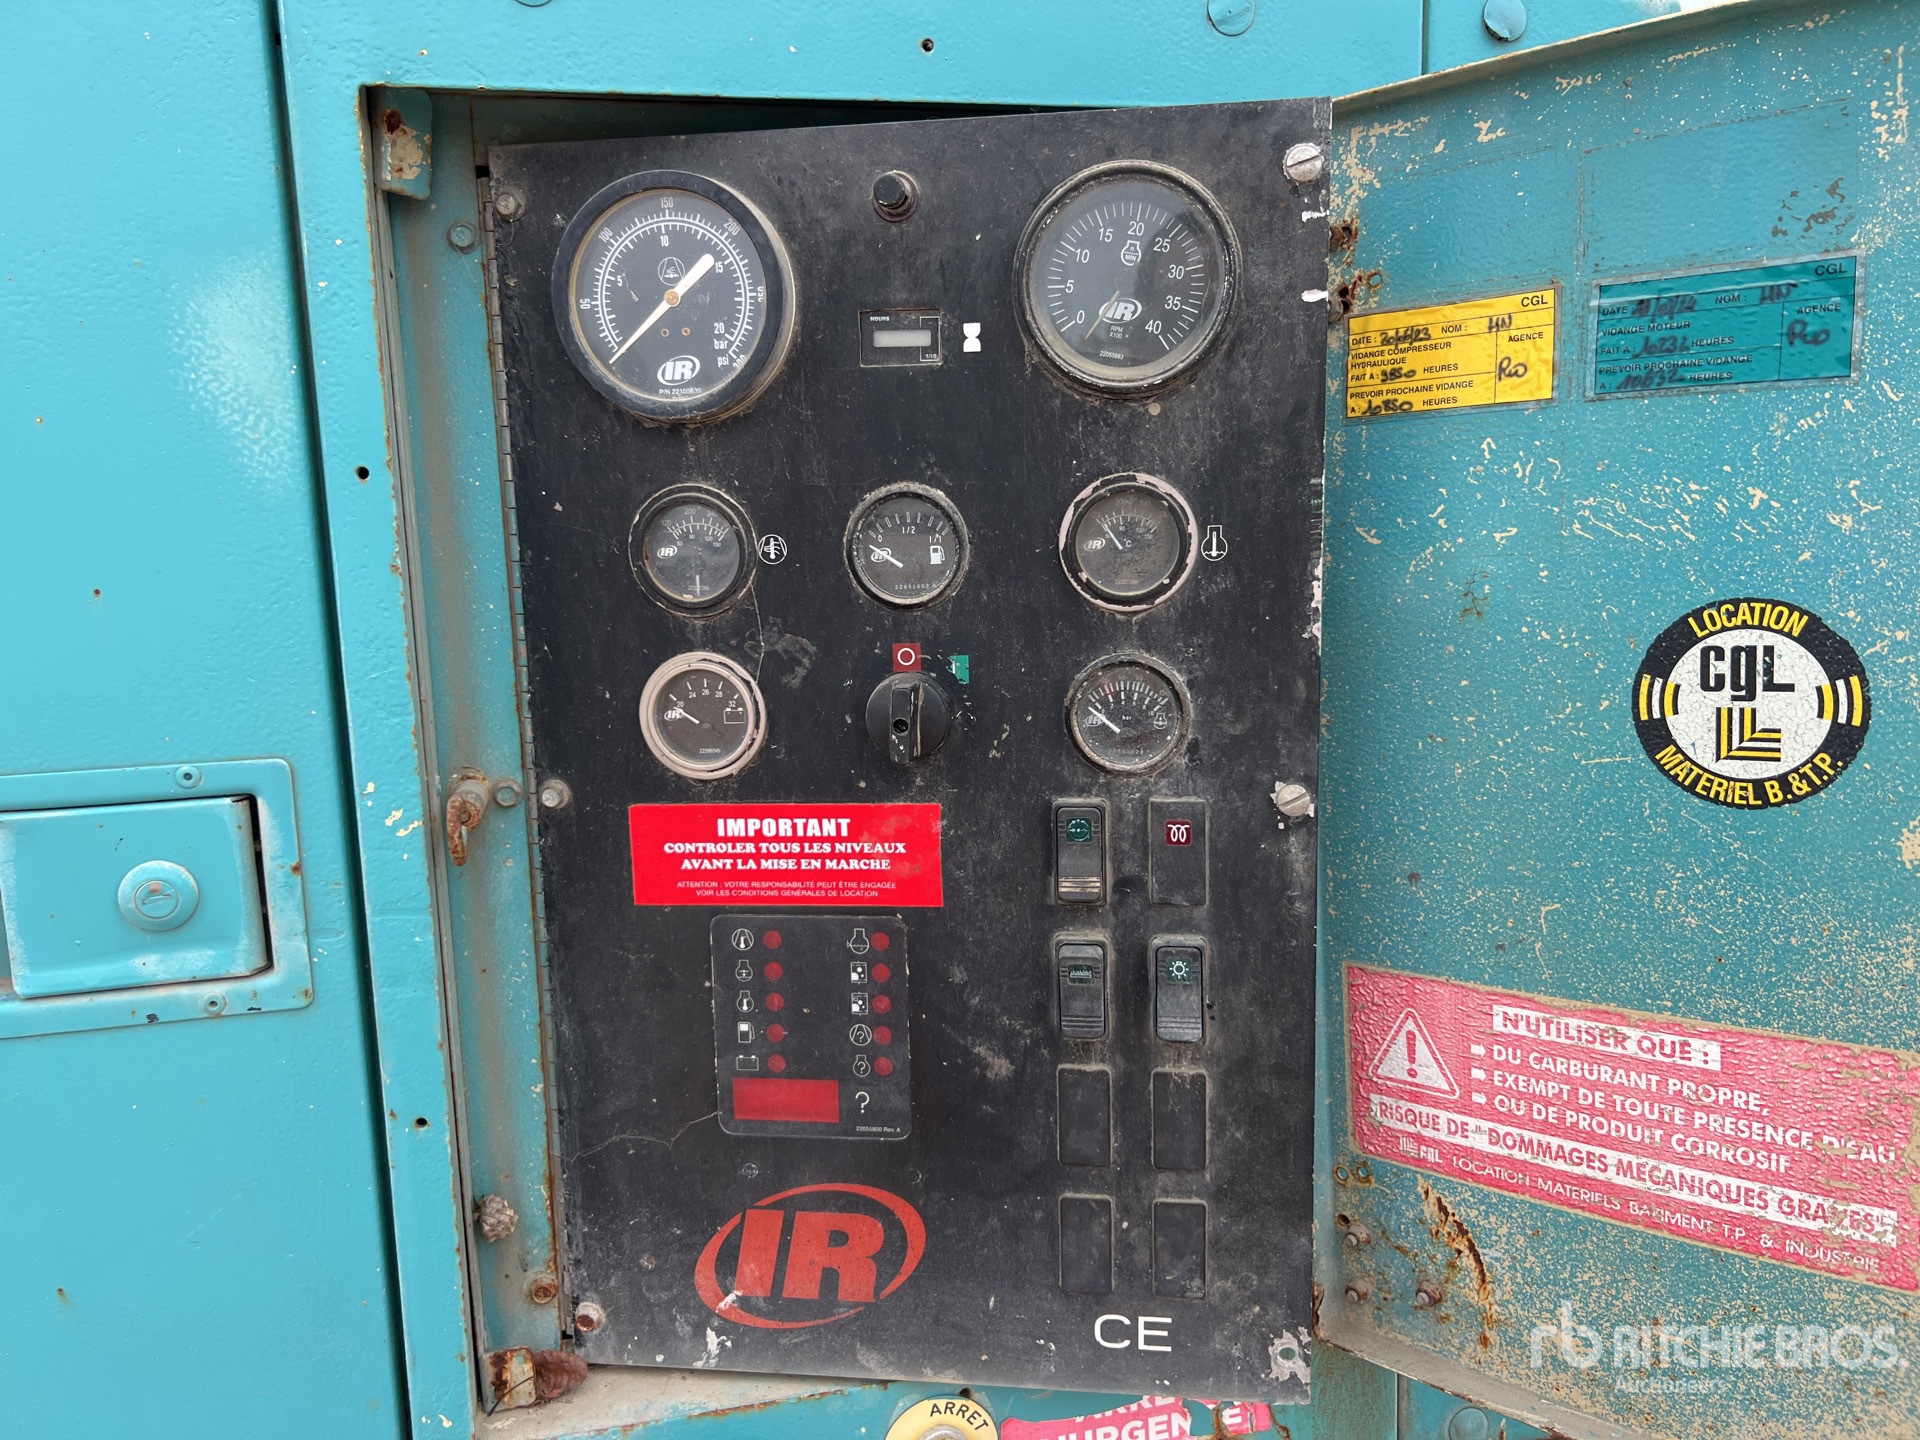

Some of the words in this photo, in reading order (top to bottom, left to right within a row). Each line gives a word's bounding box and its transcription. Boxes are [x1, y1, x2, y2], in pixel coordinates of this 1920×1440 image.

[660, 197, 674, 208] 150
[724, 218, 741, 236] 200
[1128, 221, 1144, 236] 20
[598, 226, 614, 243] 100
[660, 236, 670, 247] 10
[1098, 228, 1113, 242] 15
[1154, 238, 1170, 252] 25
[1075, 250, 1090, 264] 10
[715, 262, 724, 274] 15
[1168, 265, 1184, 280] 30
[1814, 264, 1847, 277] CGL
[617, 276, 623, 287] 5
[1066, 280, 1074, 293] 5
[580, 298, 590, 310] 50
[1164, 296, 1181, 310] 35
[1521, 295, 1548, 307] CGL
[1603, 306, 1628, 316] DATE
[1715, 294, 1740, 304] NOM
[1797, 303, 1841, 314] AGENCE
[1076, 310, 1084, 324] 0
[714, 322, 725, 334] 20
[1145, 320, 1162, 334] 40
[1602, 325, 1644, 336] VIDANGE
[1648, 321, 1690, 332] MOTEUR
[1351, 337, 1372, 345] DATE
[1441, 325, 1462, 334] NOM
[1508, 332, 1544, 342] AGENCE
[714, 338, 728, 350] bar
[1351, 348, 1385, 360] VIDANGE
[1387, 342, 1452, 355] COMPRESSEUR
[1600, 347, 1620, 355] FAIT
[1692, 337, 1734, 347] HEURES
[718, 355, 729, 368] psi
[1351, 357, 1406, 370] HYDRAULIQUE
[1599, 363, 1641, 374] PREVOIR
[1644, 360, 1703, 370] PROCHAINE
[1707, 355, 1753, 365] VIDANGE
[1351, 373, 1367, 382] FAIT
[1423, 364, 1458, 374] HEURES
[1689, 372, 1732, 382] HEURES
[1350, 388, 1383, 399] PREVOIR
[1386, 385, 1433, 397] PROCHAINE
[1436, 380, 1474, 391] VIDANGE
[1422, 397, 1457, 407] HEURES
[902, 526, 916, 534] 1/2
[1688, 602, 1808, 638] LOCATION
[1655, 744, 1762, 805] MATERIEL
[717, 818, 851, 838] IMPORTANT
[664, 842, 757, 854] CONTROLER
[760, 842, 801, 854] TOUS
[804, 842, 831, 853] LES
[835, 842, 906, 854] NIVEAUX
[681, 858, 734, 870] AVANT
[737, 859, 757, 870] LA
[760, 859, 797, 870] MISE
[801, 859, 822, 870] EN
[825, 859, 891, 870] MARCHE
[839, 880, 858, 888] ÊTRE
[1501, 1010, 1628, 1050] N'UTILISER
[1637, 1035, 1692, 1062] QUE
[1492, 1044, 1522, 1065] DU
[1528, 1052, 1659, 1092] CARBURANT
[1493, 1070, 1570, 1101] EXEMPT
[1578, 1088, 1604, 1109] DE
[1613, 1095, 1690, 1125] TOUTE
[1694, 1111, 1813, 1150] PRESENCE
[1494, 1095, 1525, 1116] OU
[1533, 1104, 1558, 1124] DE
[1566, 1110, 1664, 1145] PRODUIT
[1671, 1133, 1791, 1173] CORROSIF
[1378, 1101, 1440, 1132] RISQUE
[1447, 1118, 1469, 1139] DE
[1616, 1157, 1769, 1210] MECANIQUES
[1453, 1155, 1530, 1186] LOCATION
[1538, 1179, 1620, 1210] MATERIELS
[1760, 1234, 1773, 1248] &
[1094, 1314, 1172, 1352] CE
[930, 1402, 988, 1430] ARRET
